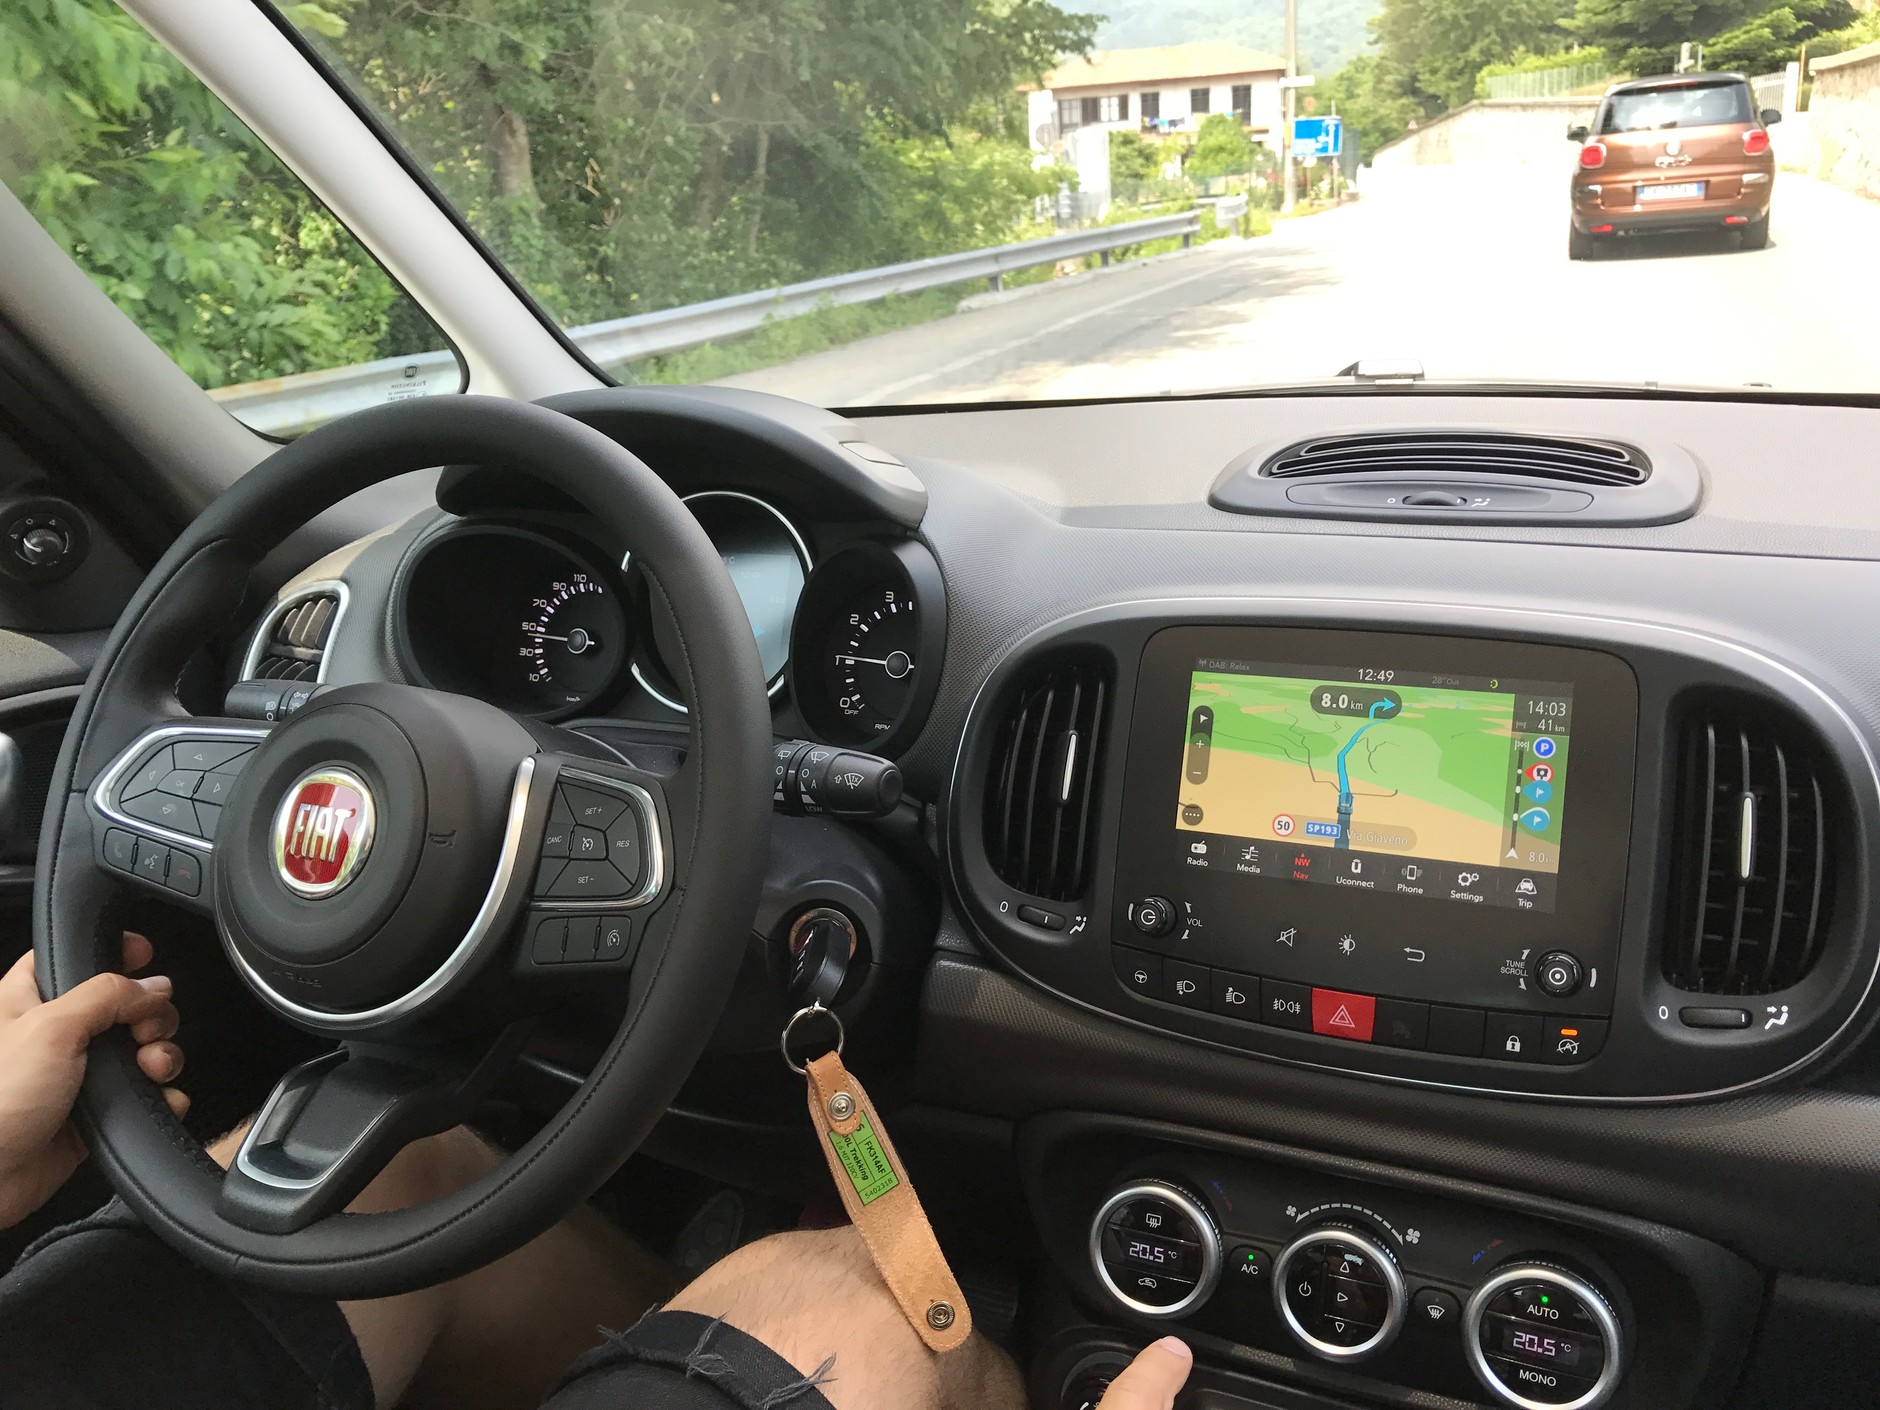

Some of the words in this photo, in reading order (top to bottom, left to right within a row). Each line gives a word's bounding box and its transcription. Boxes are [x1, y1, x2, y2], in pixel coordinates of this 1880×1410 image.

[574, 573, 587, 583] 110
[552, 582, 567, 591] 90
[885, 591, 894, 603] 3
[532, 598, 548, 608] 70
[849, 614, 859, 625] 2
[521, 621, 537, 631] 50
[519, 647, 534, 657] 30
[1229, 662, 1250, 671] Relax
[528, 673, 540, 682] 10
[1357, 668, 1394, 682] 12:49
[839, 697, 850, 708] 0
[1321, 693, 1348, 709] 8.0
[1350, 700, 1363, 710] km
[844, 708, 859, 716] OFF
[1528, 700, 1566, 716] 14:03
[1537, 718, 1552, 732] 41
[585, 807, 597, 815] SET
[1276, 820, 1290, 832] 50
[1307, 823, 1338, 836] SP193
[289, 803, 353, 863] FIAT
[1346, 829, 1362, 841] Via
[547, 835, 562, 844] CANC
[616, 840, 630, 848] RES
[1186, 857, 1208, 867] Radio
[1294, 857, 1311, 867] NW
[1528, 851, 1545, 864] 8.0
[1236, 863, 1261, 874] Media
[577, 876, 589, 884] SET
[1293, 870, 1309, 880] Nav
[1336, 875, 1375, 889] Uconnect
[1397, 883, 1424, 895] Phone
[1450, 890, 1484, 902] Settings
[1517, 898, 1533, 909] Trip
[1186, 917, 1203, 927] VOL
[1505, 959, 1525, 969] TUNE
[1500, 966, 1529, 977] SCROLL
[864, 1140, 886, 1175] FK314AF
[850, 1148, 869, 1181] Trekking
[1129, 1241, 1165, 1263] 20.5
[1241, 1263, 1259, 1275] A/C
[1527, 1304, 1559, 1320] AUTO
[1512, 1331, 1556, 1356] 20.5
[1519, 1369, 1557, 1387] MONO
